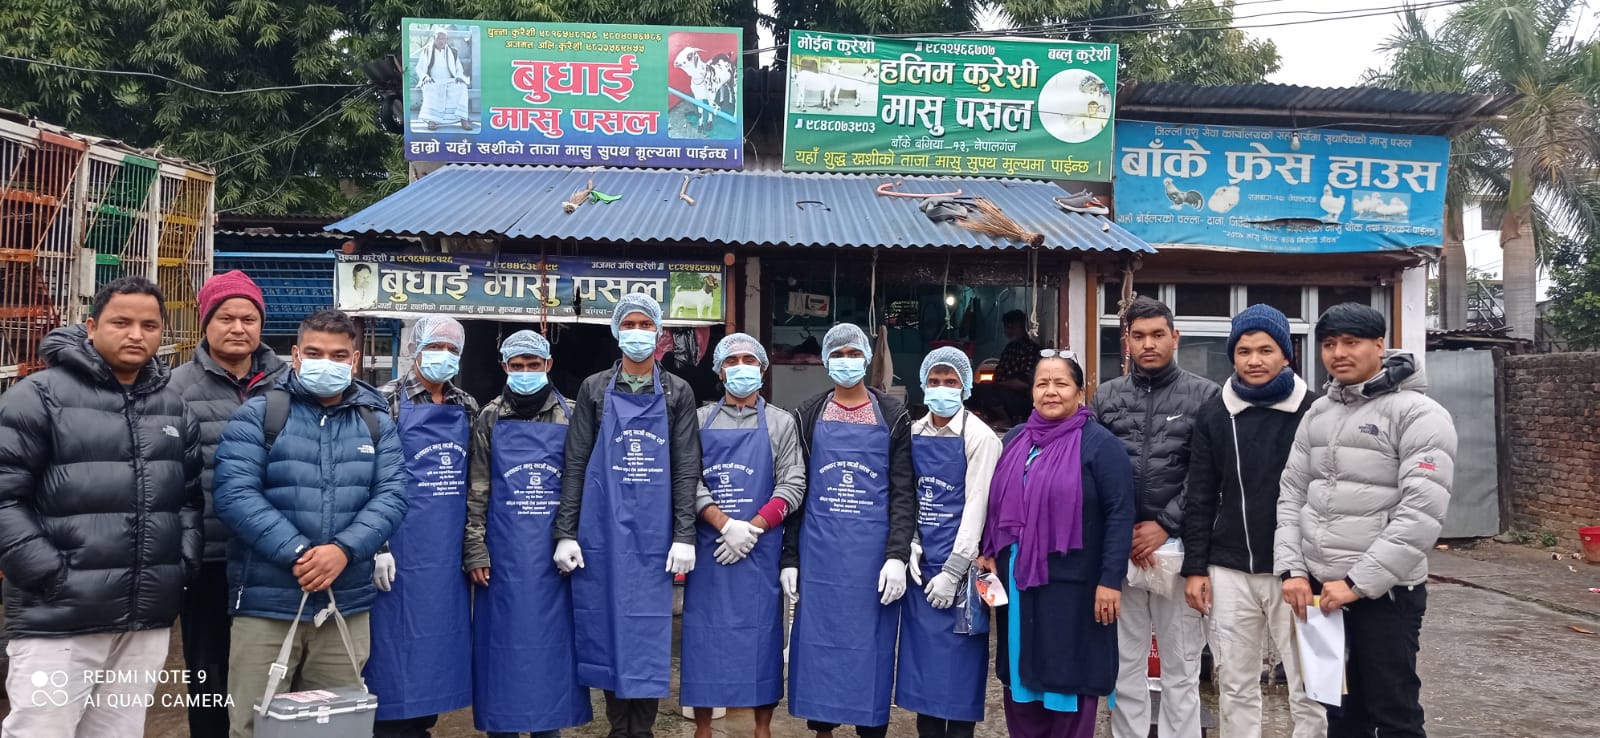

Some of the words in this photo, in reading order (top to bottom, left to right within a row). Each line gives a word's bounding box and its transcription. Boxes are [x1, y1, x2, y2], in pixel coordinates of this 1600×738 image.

[797, 35, 832, 51] मोईन
[836, 37, 875, 54] कुरेशी
[1048, 47, 1072, 64] बब्लु
[1076, 46, 1111, 64] कुरेशी
[512, 54, 639, 103] बुधाई
[879, 53, 956, 85] हलिम
[963, 57, 1041, 93] कुरेशी
[490, 106, 564, 138] मासु
[572, 108, 660, 134] पसल
[882, 94, 947, 138] मासु
[955, 97, 1035, 131] पसल
[410, 139, 440, 154] हाम्रो
[445, 139, 471, 155] यहाँ
[476, 139, 524, 155] खशीको
[529, 144, 560, 156] ताजा
[565, 145, 592, 159] मासु
[597, 146, 631, 159] सुपथ
[635, 147, 681, 160] मूल्यमा
[686, 146, 729, 161] पाईन्छ
[891, 135, 911, 149] बाँके
[974, 138, 1017, 152] नेपालगंज
[795, 147, 819, 164] यहाँ
[823, 150, 847, 169] शुद्ध
[852, 148, 896, 166] खशीको
[901, 154, 929, 167] ताजा
[935, 155, 961, 172] मासु
[966, 156, 998, 173] सुपथ
[1002, 157, 1046, 174] मुल्यमा
[1051, 155, 1089, 175] पाईन्छ
[1121, 138, 1211, 178] बाँके
[1225, 142, 1315, 185] फ्रेस
[1328, 155, 1441, 192] हाउस
[381, 265, 472, 302] बुधाई
[484, 272, 561, 306] मासु
[572, 276, 667, 304] पसल
